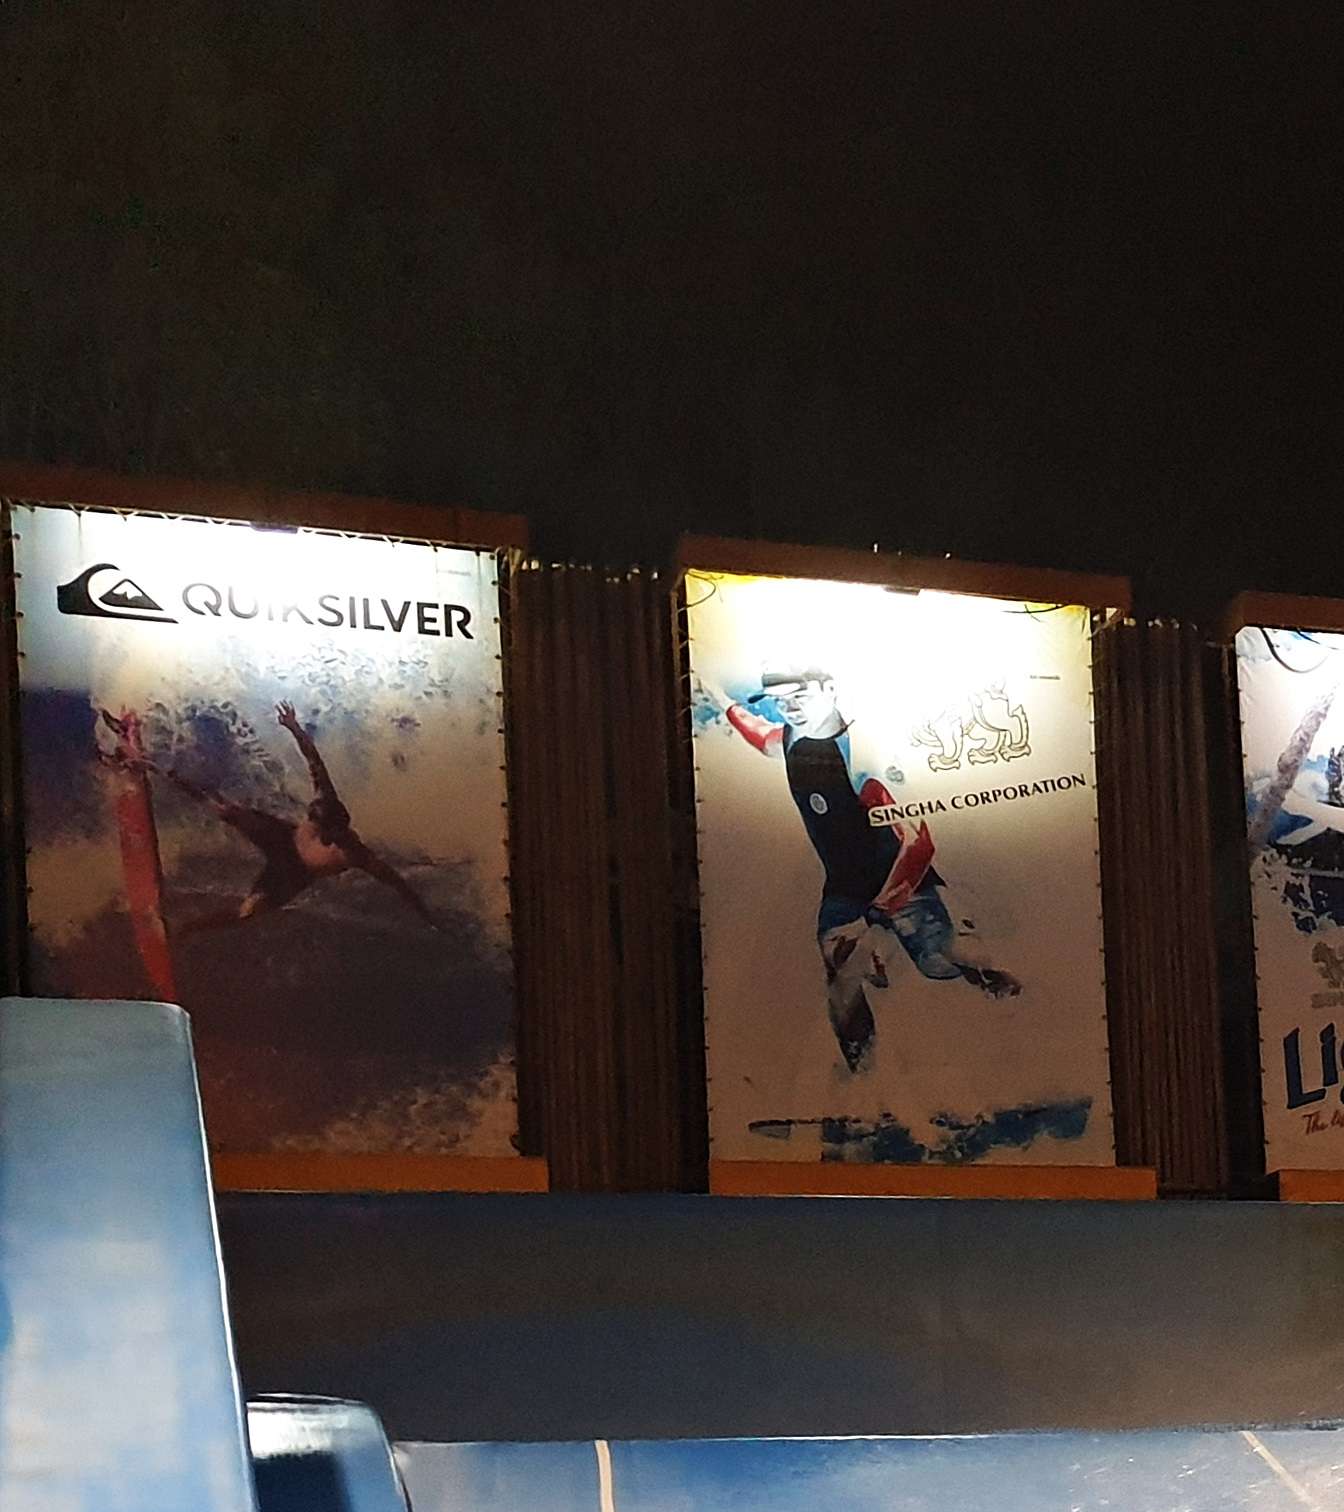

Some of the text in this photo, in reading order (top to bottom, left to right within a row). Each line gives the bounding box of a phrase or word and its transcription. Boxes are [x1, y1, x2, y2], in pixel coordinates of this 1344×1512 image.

[182, 582, 475, 640] QUIKSILVER
[871, 773, 1087, 825] SINGHA CORPORATION
[1302, 1110, 1329, 1136] The
